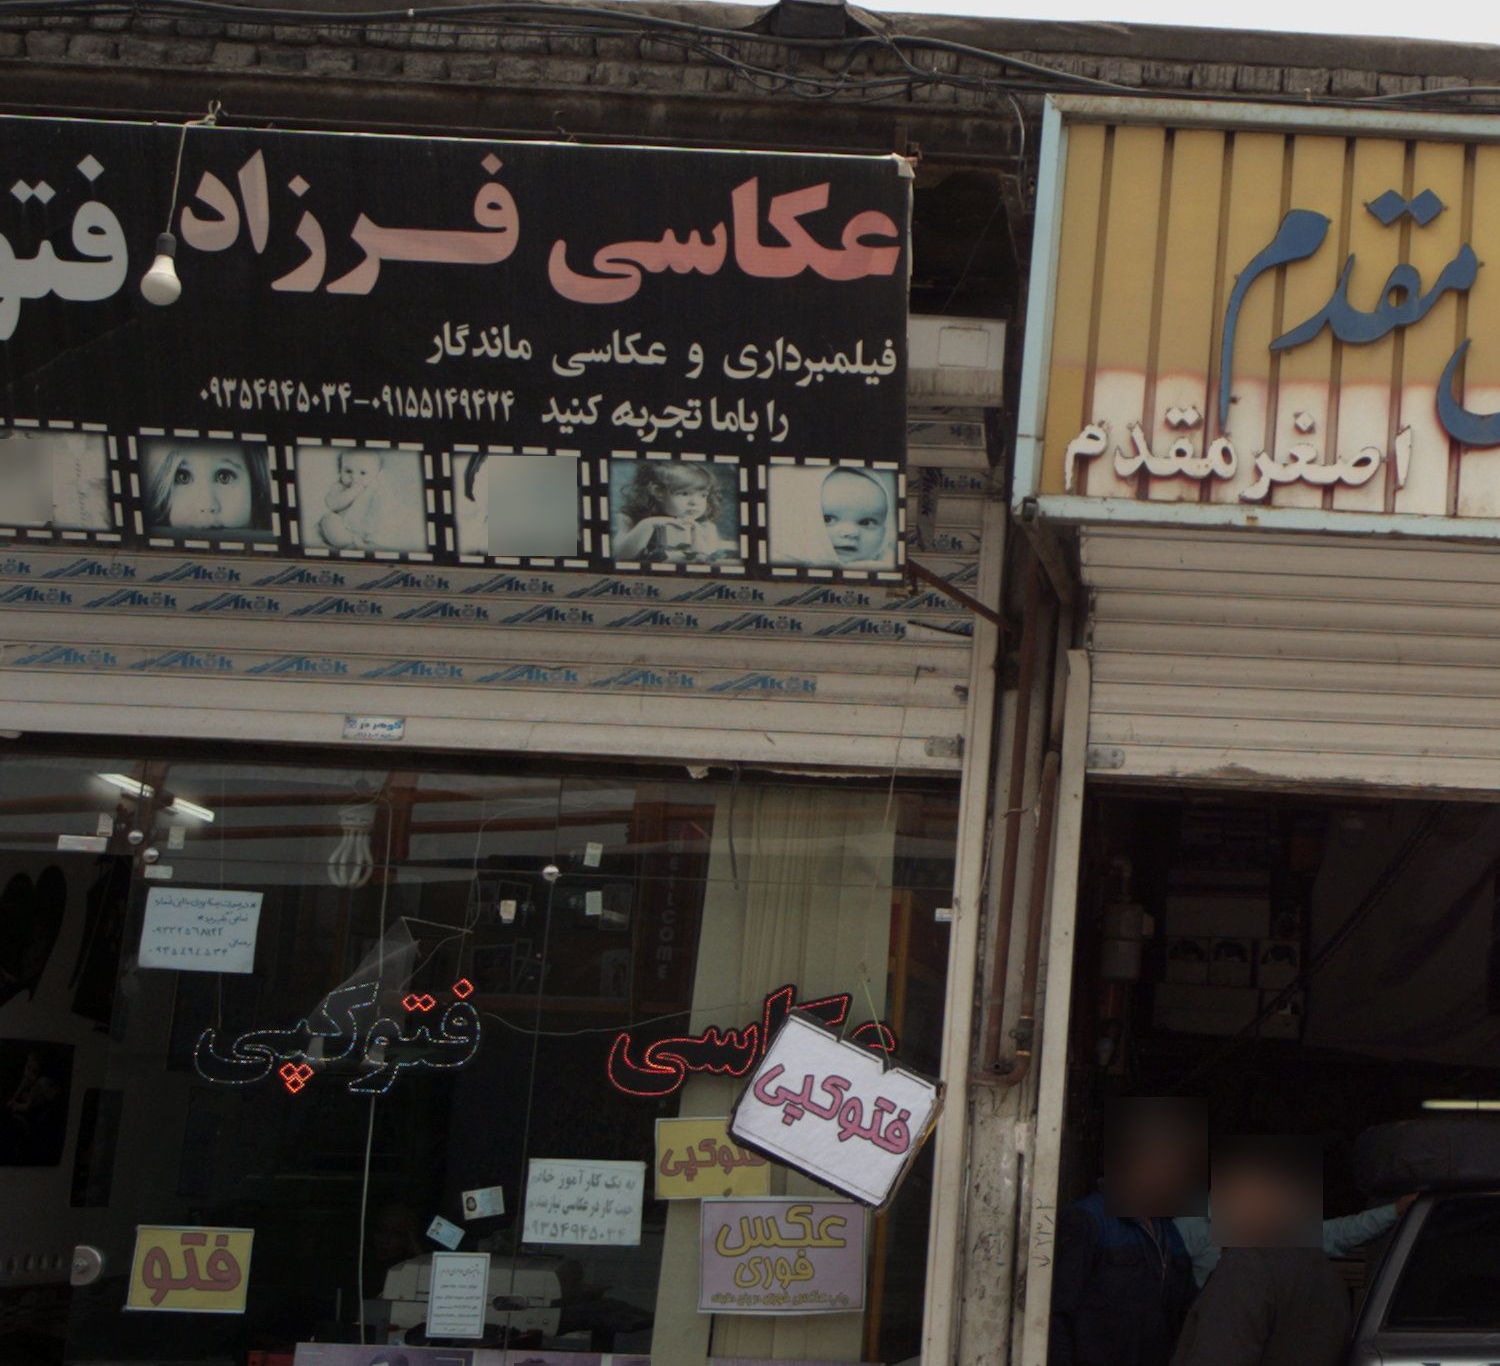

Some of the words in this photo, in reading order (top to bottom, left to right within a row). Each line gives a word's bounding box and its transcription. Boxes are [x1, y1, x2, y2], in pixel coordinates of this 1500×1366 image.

[180, 149, 521, 296] فرزاد
[547, 176, 902, 305] عکاسی
[1216, 186, 1484, 431] مقدم
[425, 321, 534, 364] ماندگار
[550, 329, 668, 377] عکاسی
[685, 341, 705, 377] و
[722, 336, 897, 386] فیلمبرداری
[540, 393, 603, 434] کنید
[610, 397, 703, 443] تجربه
[765, 398, 790, 442] را
[1064, 404, 1237, 492] مقدم
[1238, 411, 1414, 501] اصغر
[193, 977, 481, 1097] فتوکپی
[753, 1062, 912, 1155] فتوکپی
[714, 1204, 848, 1258] عکس
[141, 1231, 243, 1306] فتو
[733, 1248, 815, 1290] فوری
